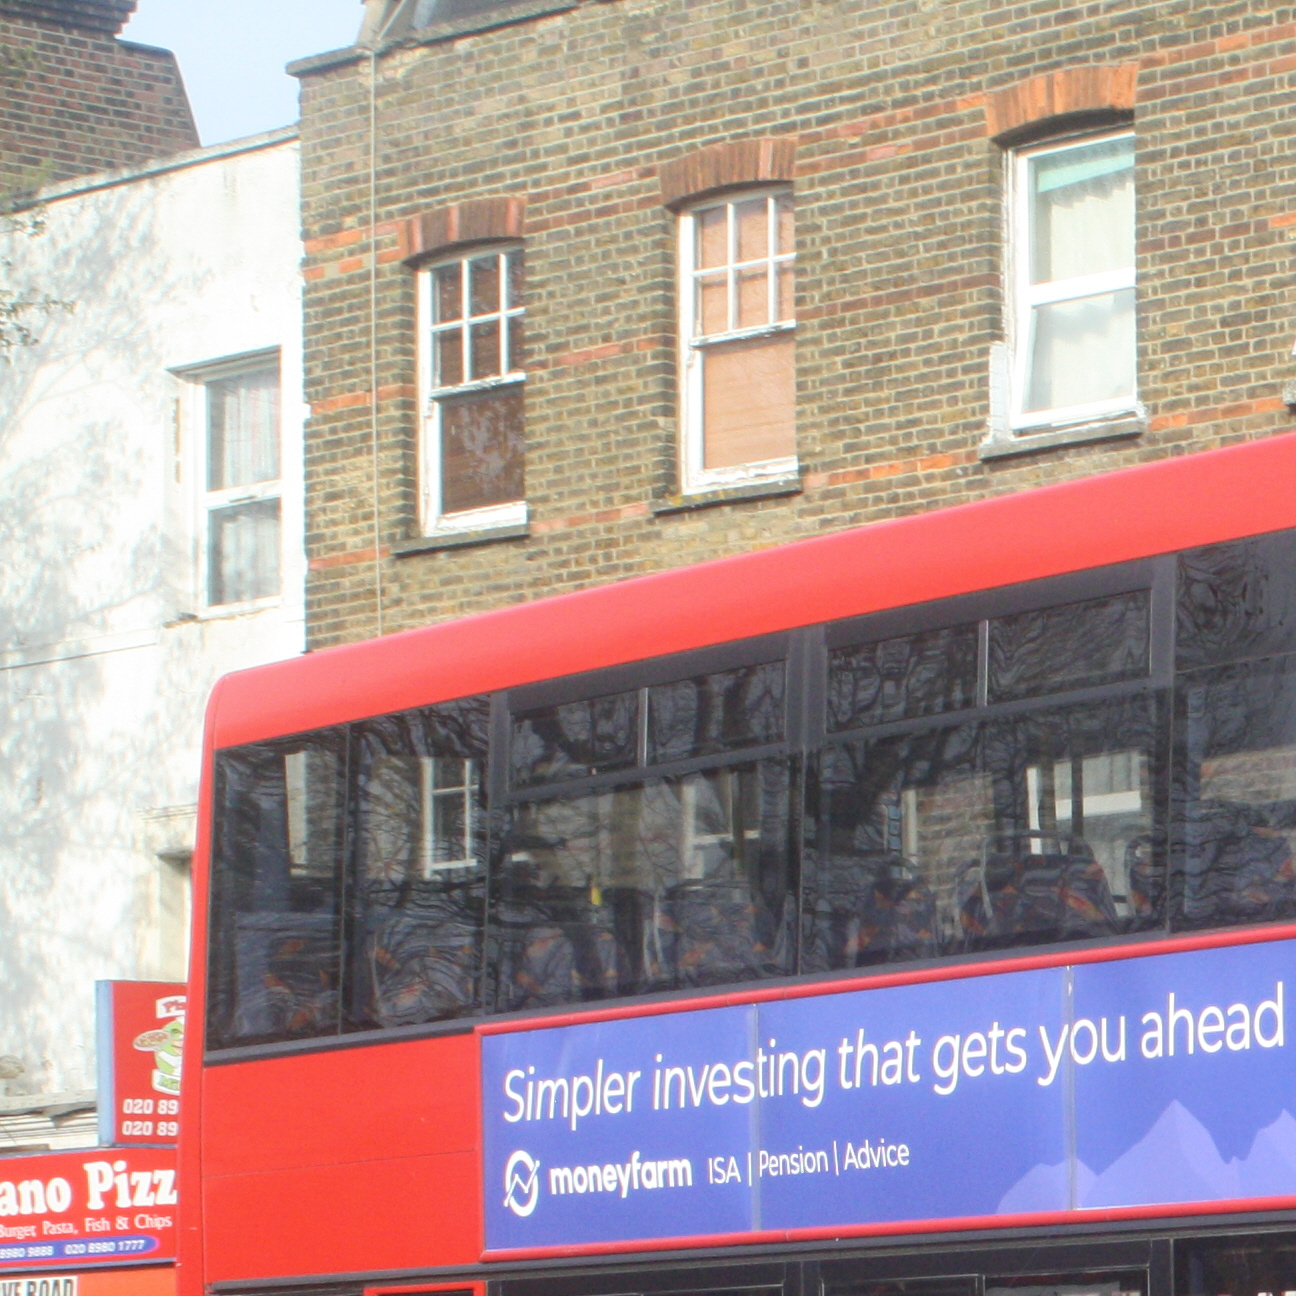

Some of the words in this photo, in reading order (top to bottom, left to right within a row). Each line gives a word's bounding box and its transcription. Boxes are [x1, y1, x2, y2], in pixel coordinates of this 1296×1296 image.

[503, 1058, 642, 1132] Simpler
[653, 1038, 827, 1108] investing
[838, 1028, 922, 1090] that
[932, 1021, 1028, 1096] gets
[1037, 1015, 1127, 1087] you
[1140, 981, 1286, 1059] ahead
[122, 1098, 153, 1115] 020
[121, 1120, 152, 1136] 020
[549, 1150, 693, 1199] moneyfarm
[708, 1155, 742, 1185] ISA
[759, 1144, 829, 1178] Pension
[843, 1137, 910, 1171] Advice
[85, 1217, 111, 1232] Fish
[115, 1215, 129, 1231] &
[134, 1213, 173, 1231] Chips
